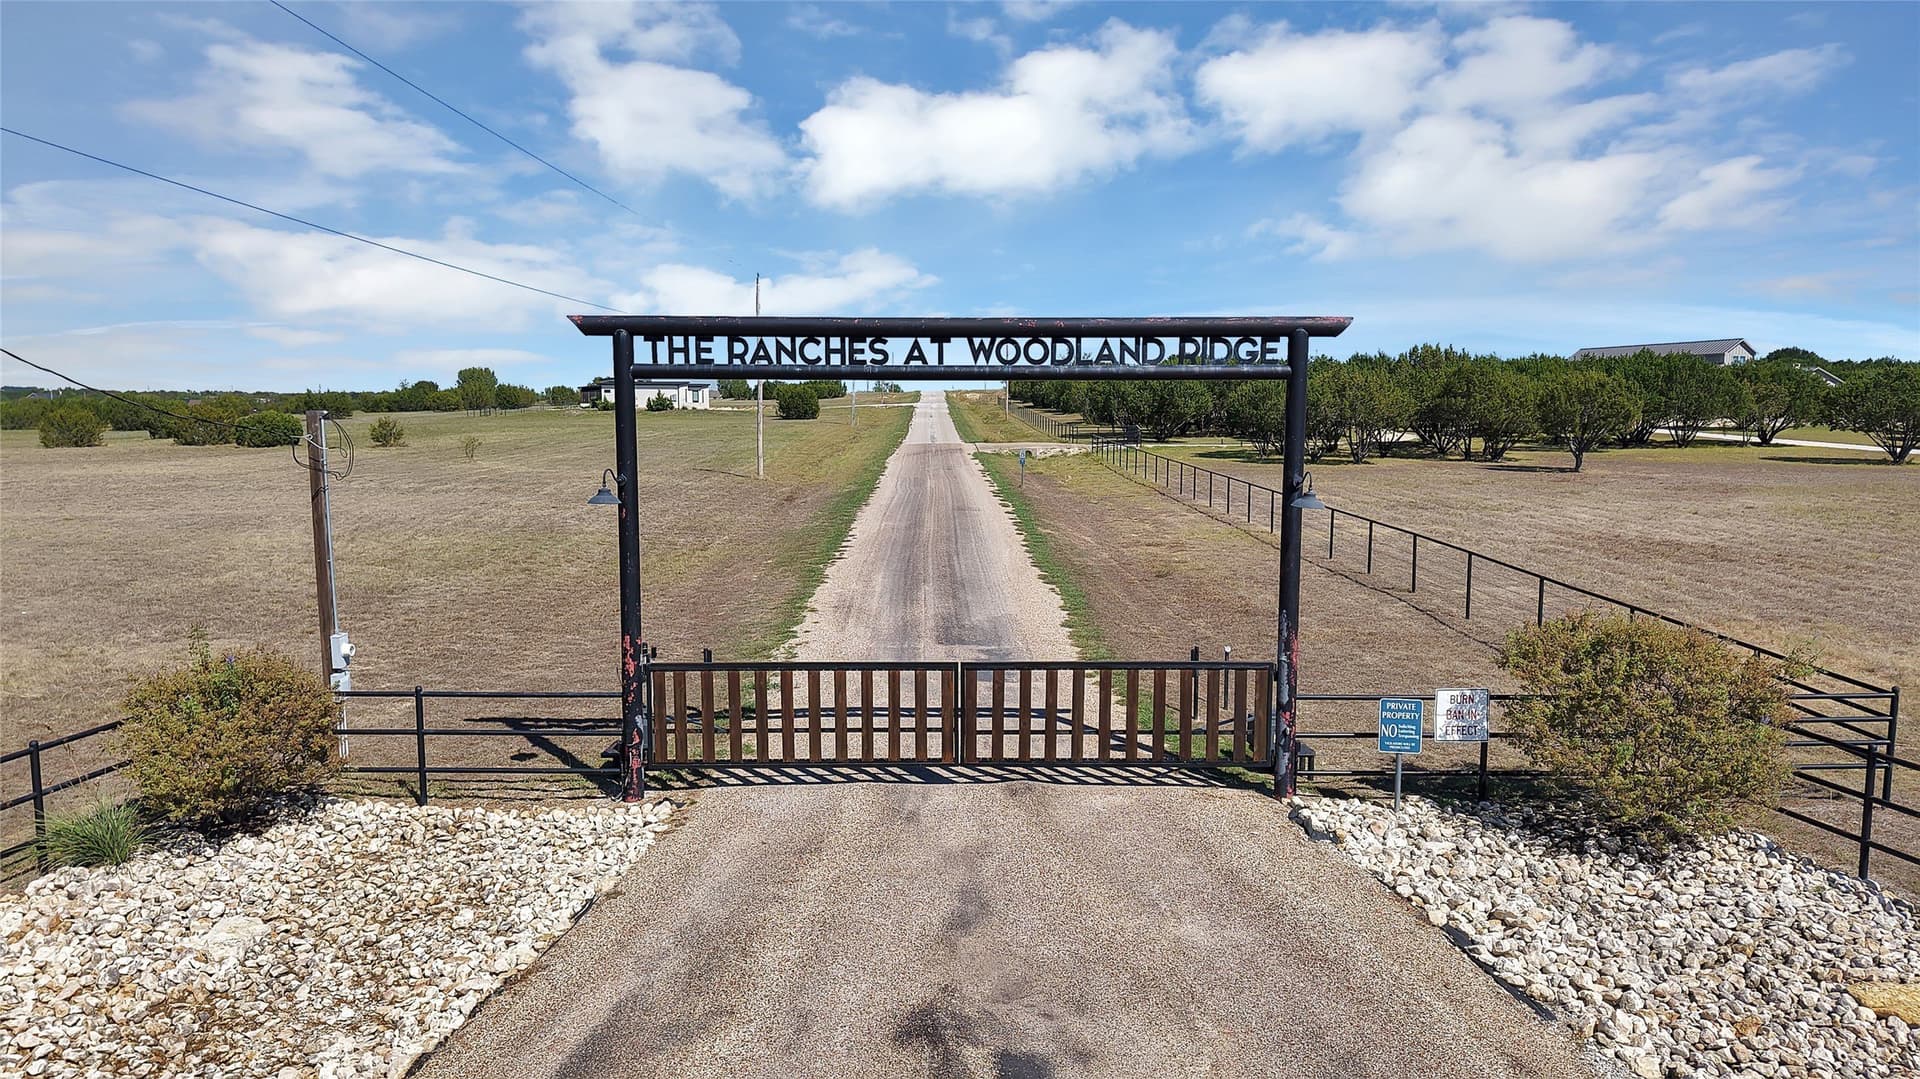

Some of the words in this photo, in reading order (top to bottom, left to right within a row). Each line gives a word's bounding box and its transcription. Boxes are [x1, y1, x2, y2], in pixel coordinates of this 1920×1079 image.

[644, 336, 714, 365] THE
[727, 336, 890, 365] RANCHES
[903, 336, 951, 365] AT
[967, 336, 1166, 365] WOODLAND
[1178, 336, 1281, 365] RIDGE
[1449, 694, 1475, 705] BURN
[1386, 702, 1417, 711] PRIVATE
[1382, 711, 1420, 720] PROPERTY
[1446, 709, 1464, 720] BAN
[1467, 709, 1477, 720] IN
[1381, 723, 1398, 738] NO
[1445, 725, 1479, 736] EFFECT
